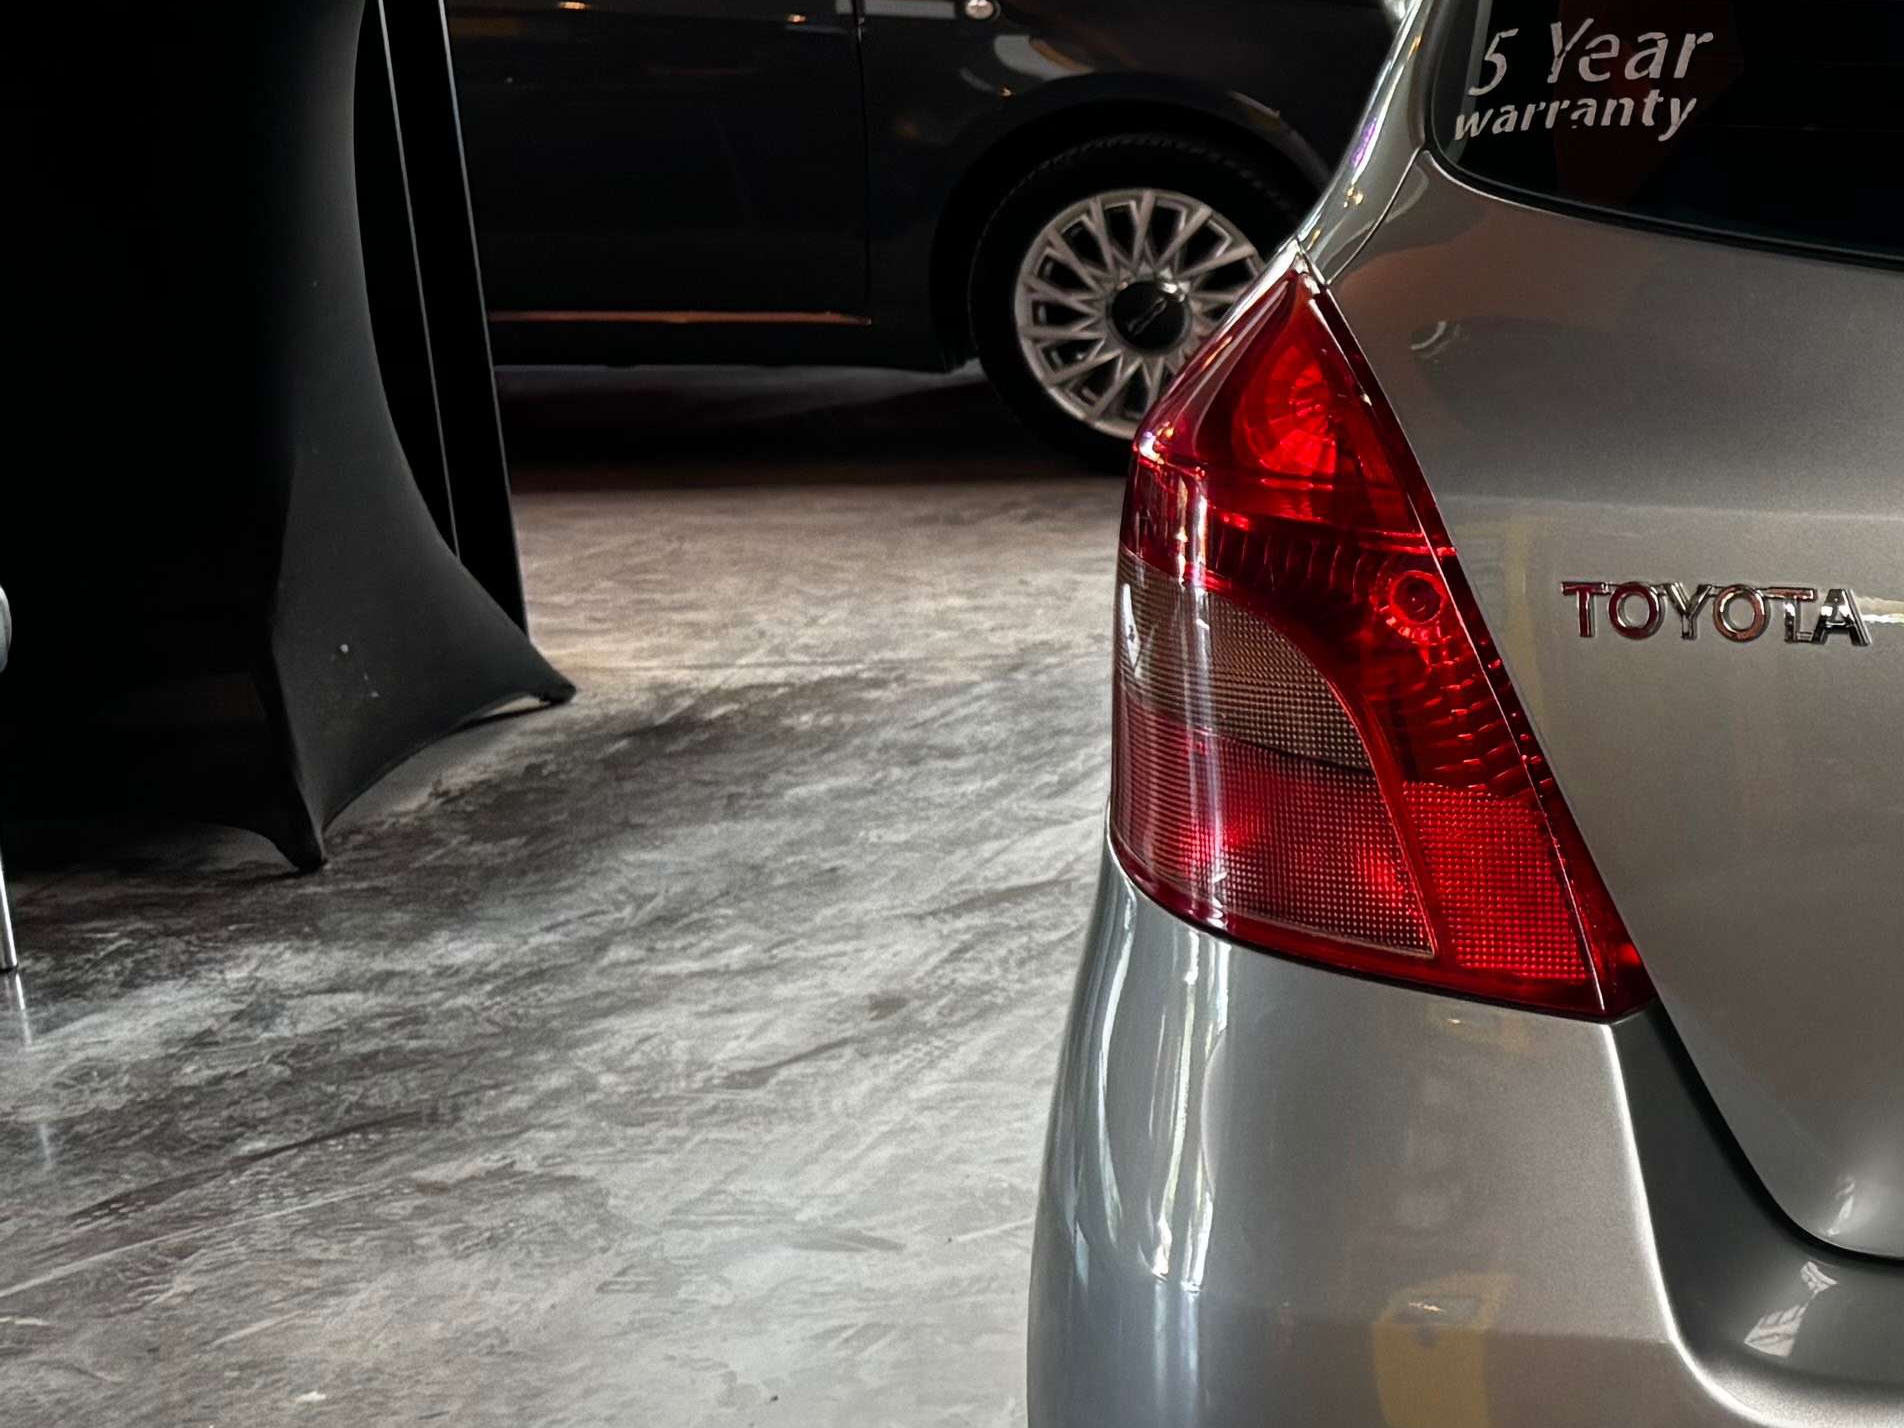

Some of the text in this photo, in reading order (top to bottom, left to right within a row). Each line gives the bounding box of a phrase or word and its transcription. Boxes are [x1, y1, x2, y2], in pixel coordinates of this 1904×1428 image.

[1468, 18, 1714, 96] 5 Year
[1454, 89, 1697, 141] warranty
[1560, 580, 1872, 645] TOYOTA
